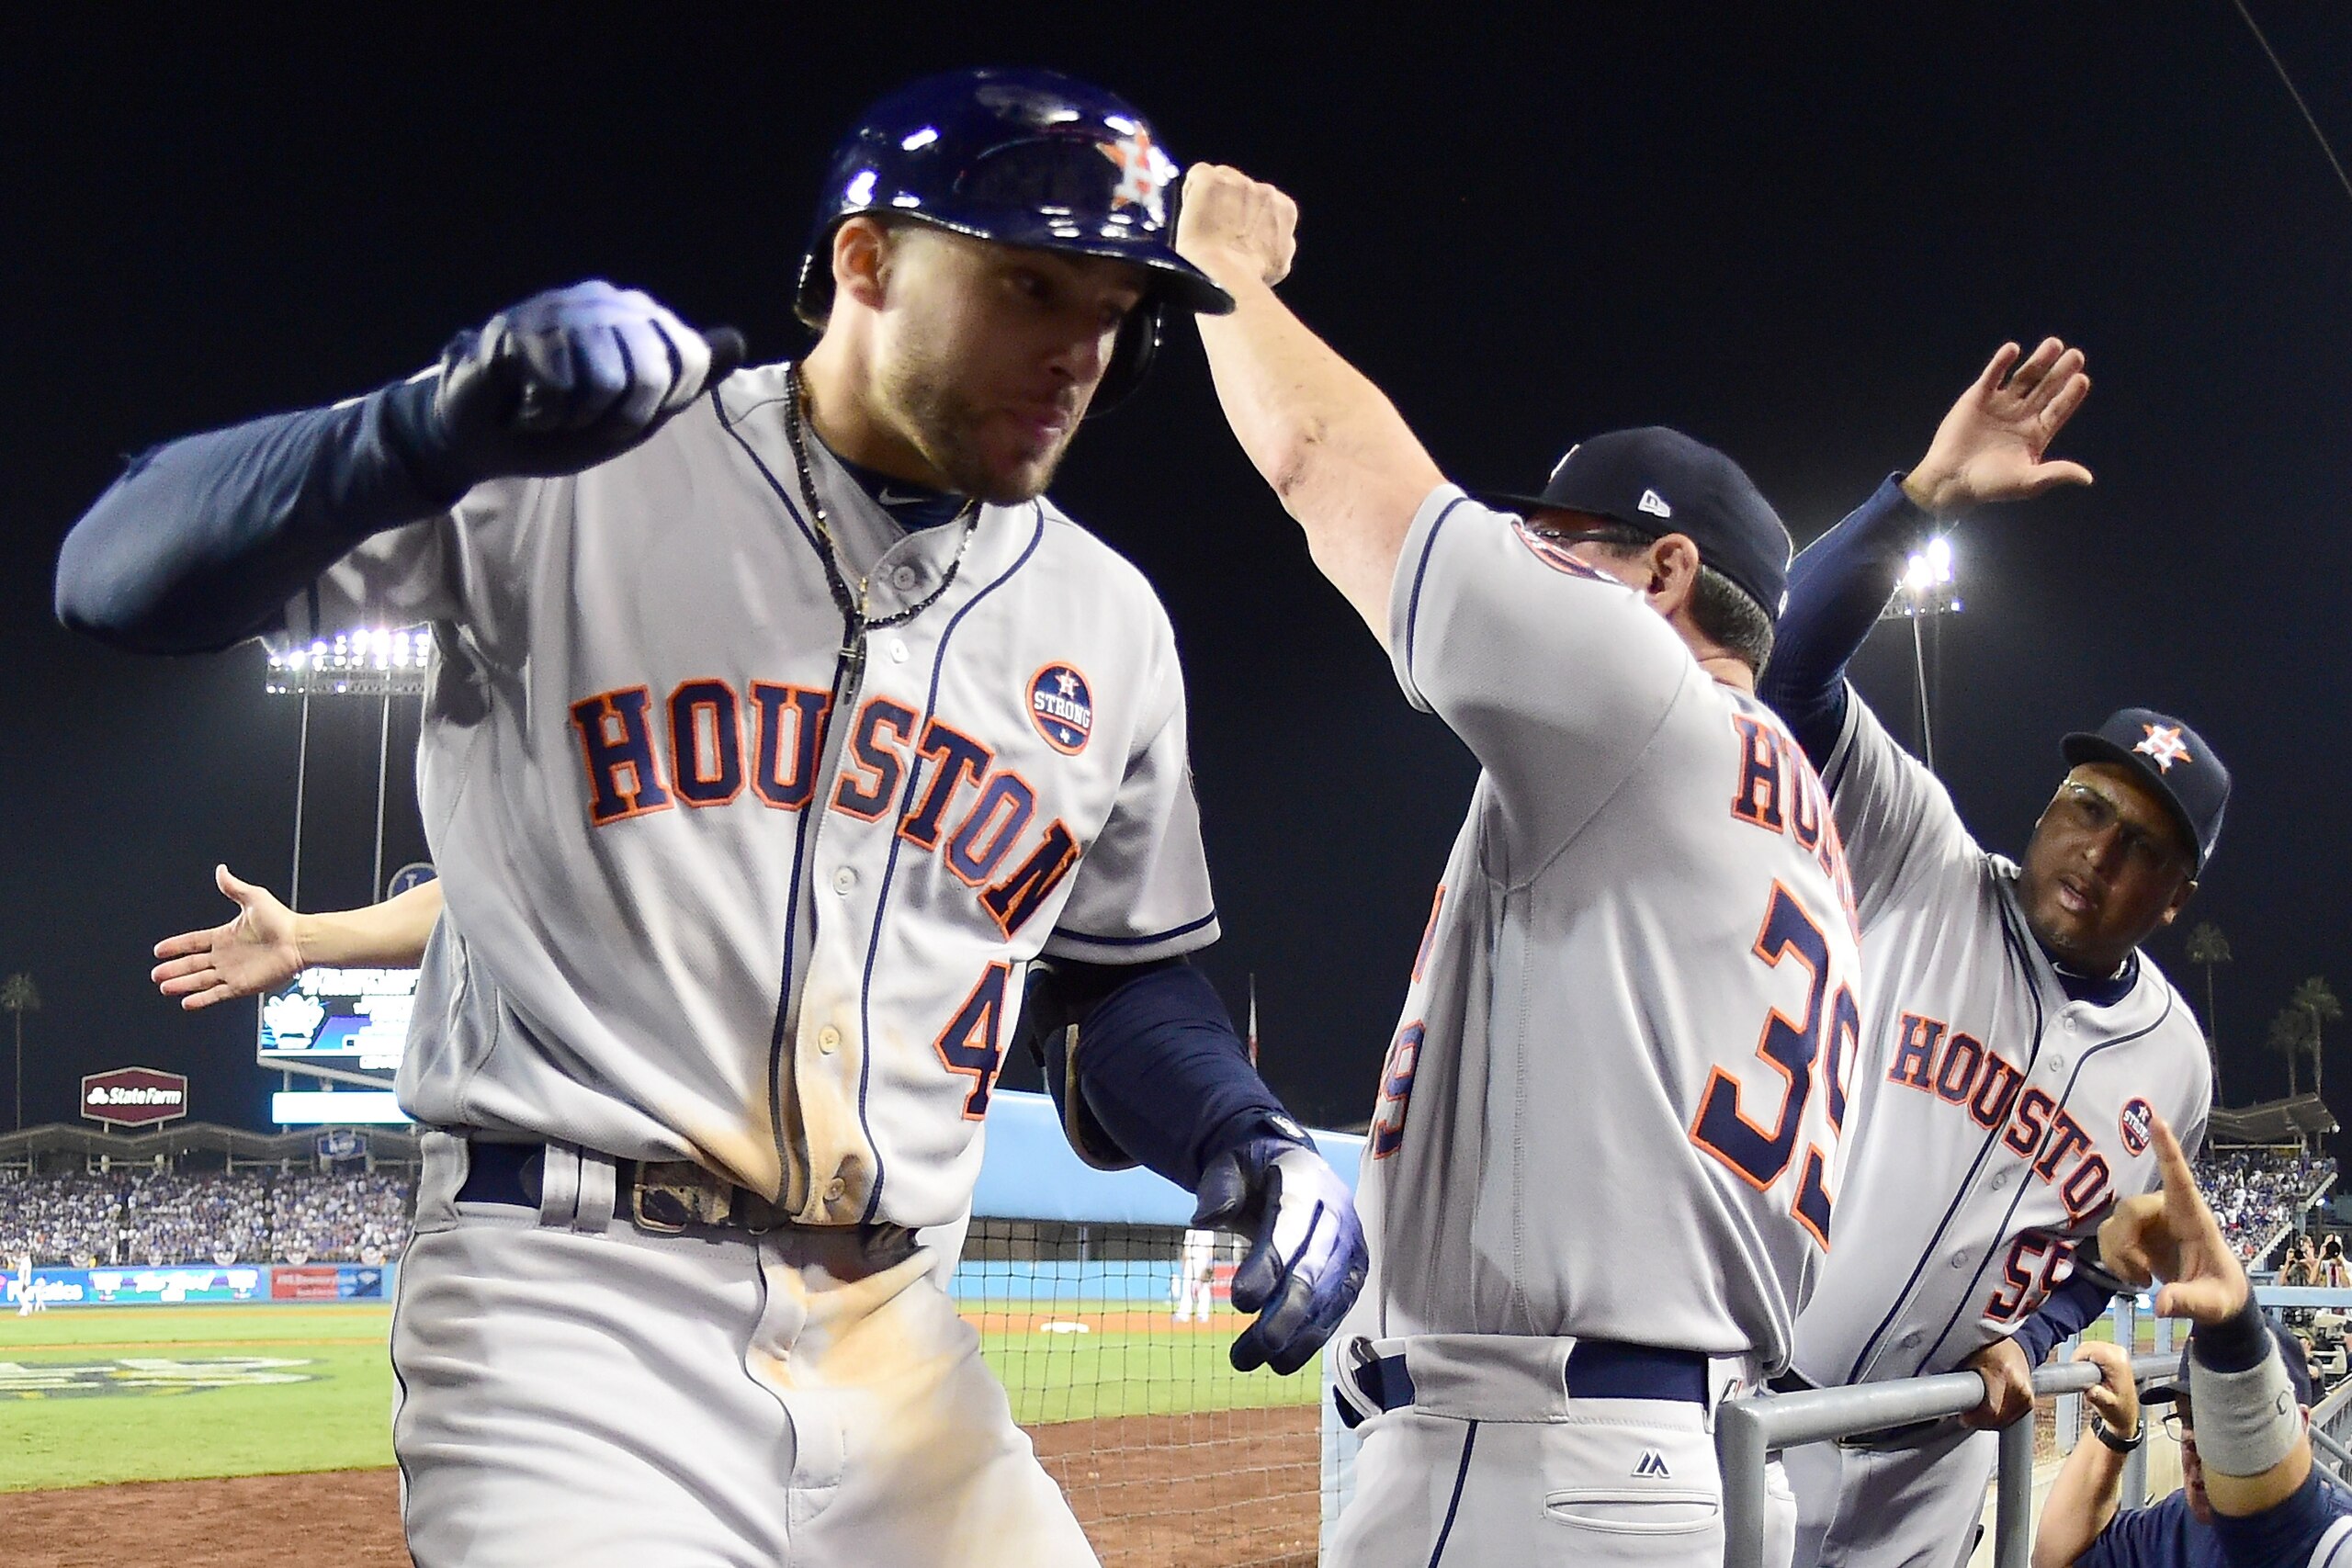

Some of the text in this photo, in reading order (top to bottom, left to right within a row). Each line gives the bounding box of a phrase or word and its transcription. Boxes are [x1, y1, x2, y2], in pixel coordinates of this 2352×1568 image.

[569, 678, 1080, 942] HOUSTON
[1034, 690, 1091, 728] STRONG
[933, 960, 1010, 1121] 4
[1689, 877, 1860, 1254] 39
[1886, 1010, 2116, 1229] HOUSTO
